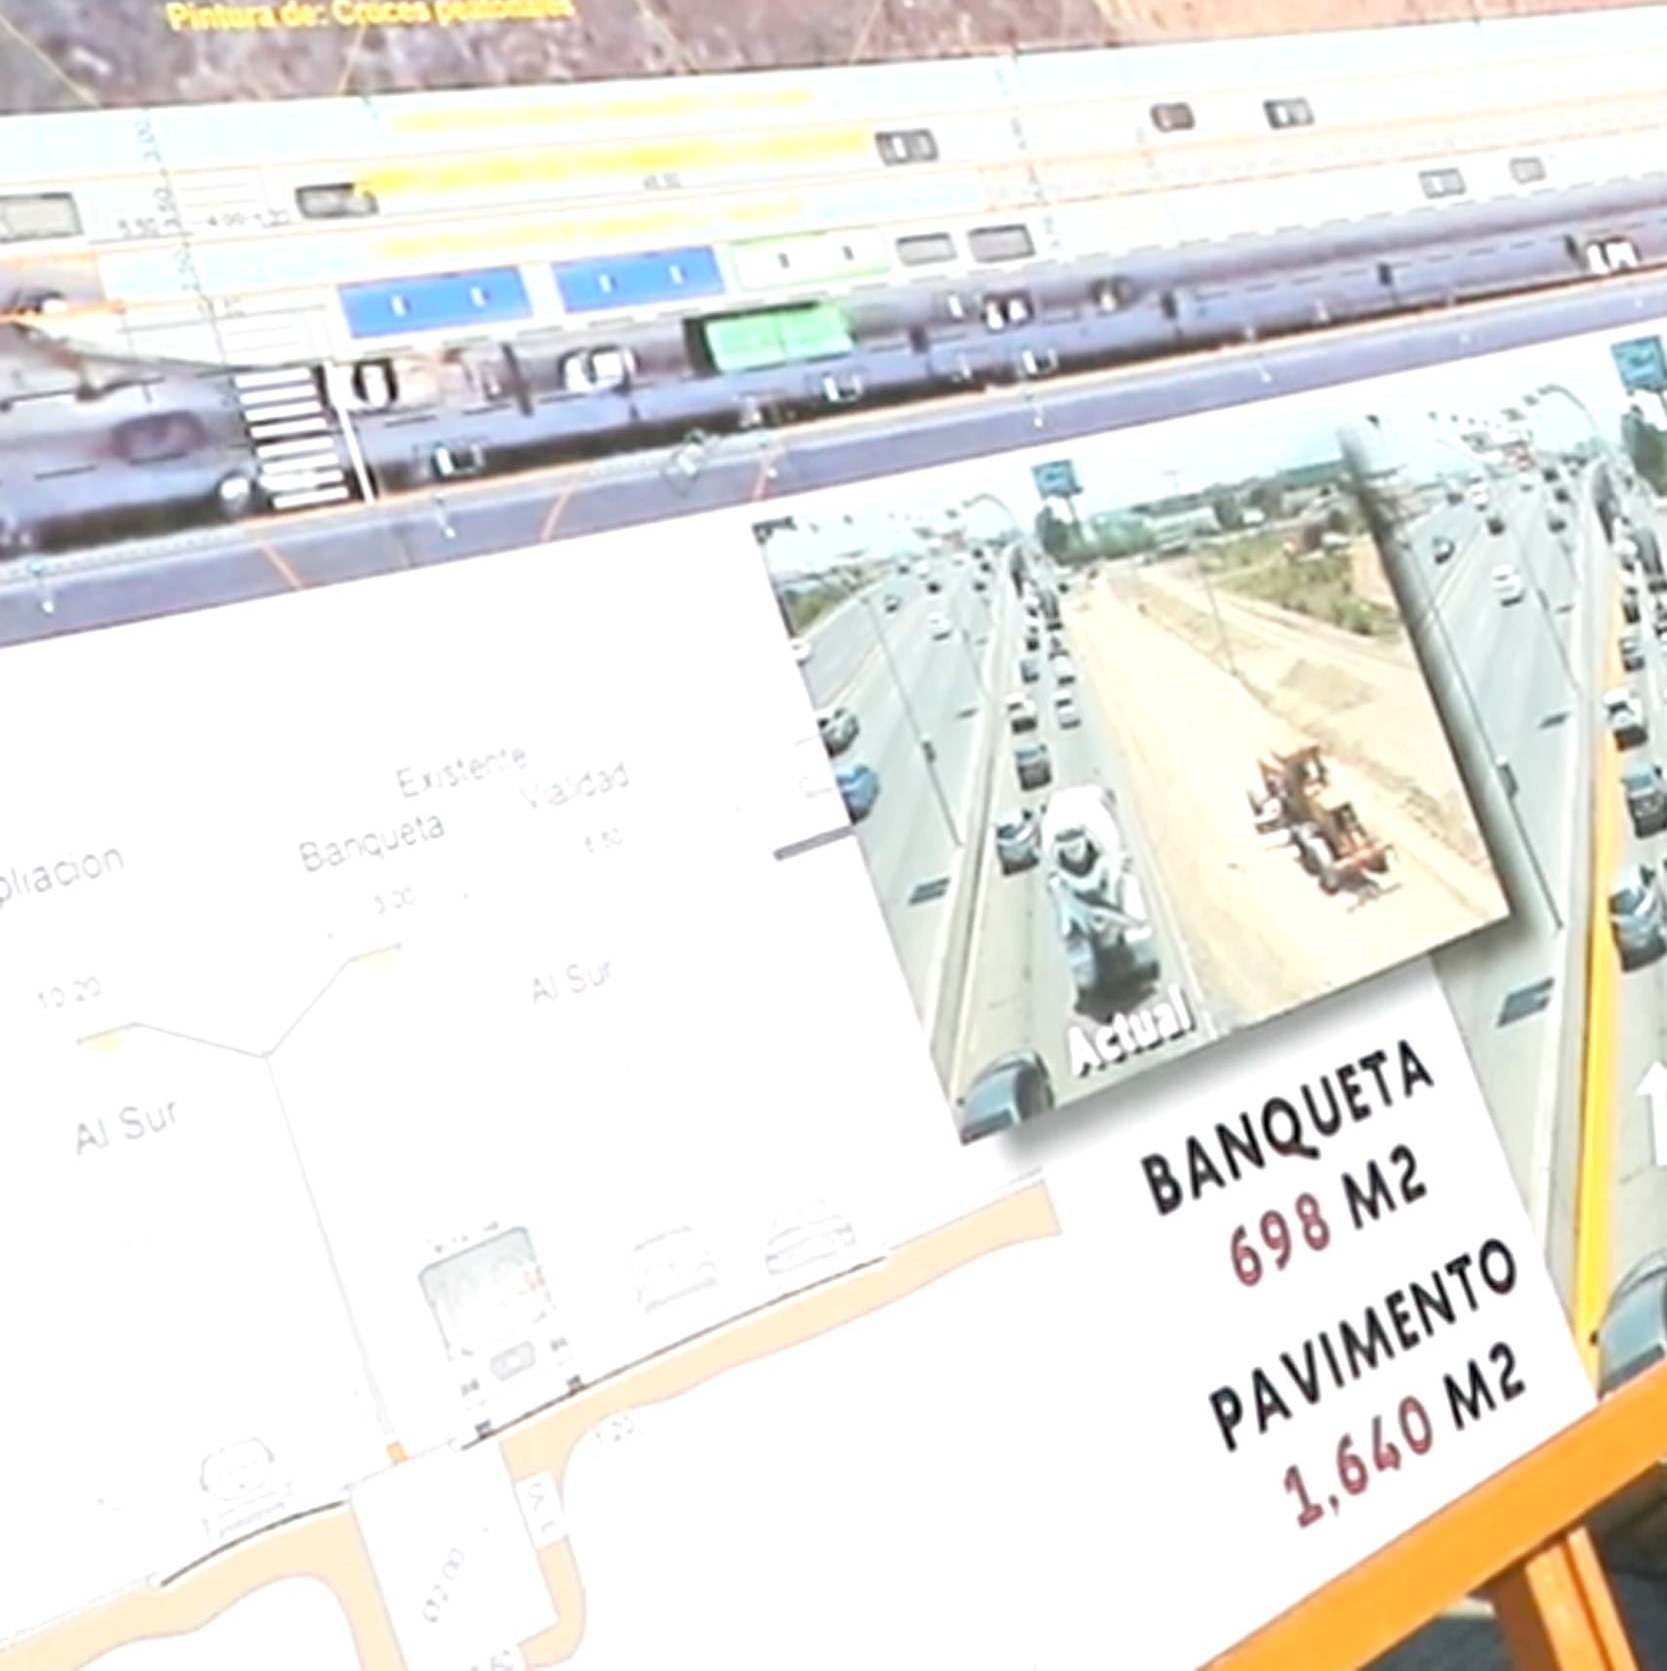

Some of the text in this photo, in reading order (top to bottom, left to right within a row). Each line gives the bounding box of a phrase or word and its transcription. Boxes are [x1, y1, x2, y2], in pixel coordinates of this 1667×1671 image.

[299, 815, 446, 872] Banqueta
[1069, 984, 1193, 1077] Actual
[119, 1101, 176, 1141] Sur
[1140, 1038, 1434, 1217] BANQUETA
[1229, 1144, 1428, 1288] 698 M2
[1209, 1237, 1518, 1451] PAVIMENTO
[1284, 1343, 1526, 1528] 1,640 M2
